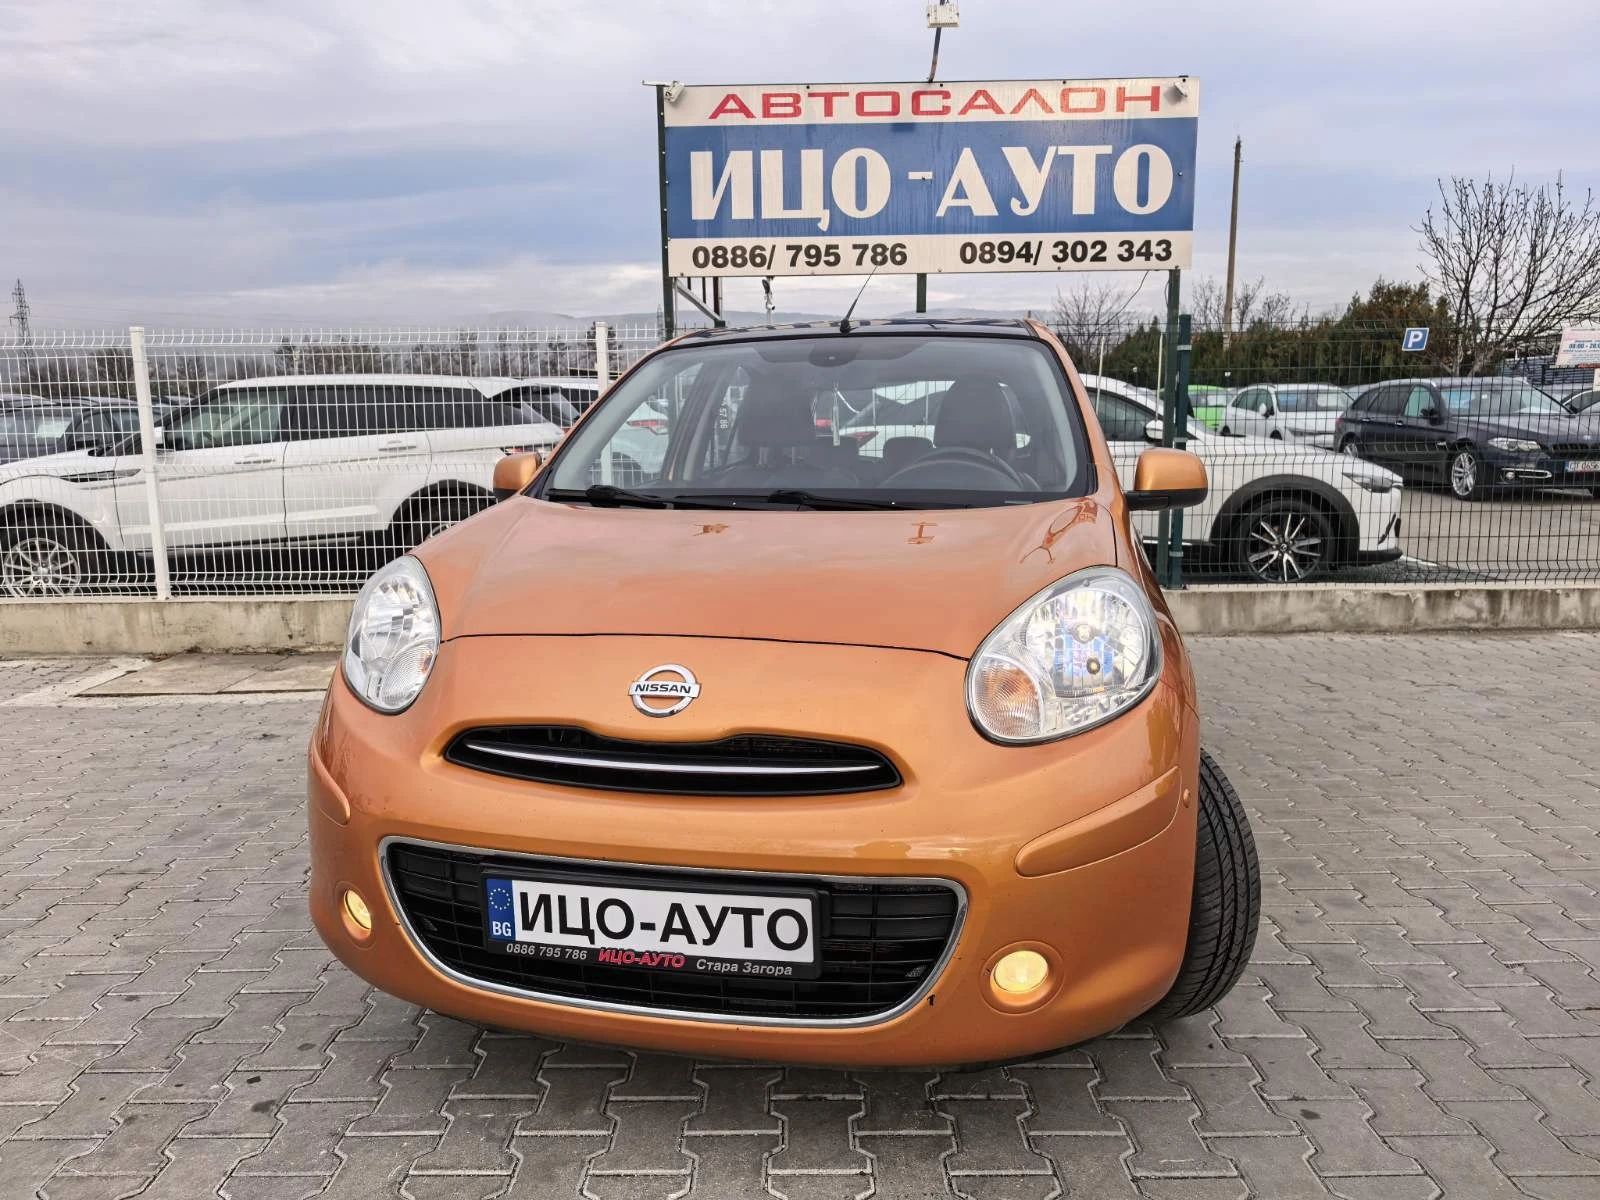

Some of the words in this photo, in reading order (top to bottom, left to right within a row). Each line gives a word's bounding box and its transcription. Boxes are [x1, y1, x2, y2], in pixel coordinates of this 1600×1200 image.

[708, 86, 1160, 119] АВТОСАЛОН
[692, 245, 776, 269] 0886/
[786, 244, 841, 267] 795
[852, 243, 907, 266] 786
[959, 240, 1043, 265] 0894/
[1052, 240, 1107, 263] 302
[1117, 239, 1172, 262] 343
[1408, 330, 1423, 348] P
[635, 684, 691, 694] NISSAN
[492, 921, 512, 937] BG
[519, 891, 808, 951] ИЦО-АУТО
[506, 943, 535, 955] 0886
[539, 946, 561, 958] 795
[565, 948, 588, 960] 786
[598, 948, 686, 968] ИЦО-АУТО
[696, 959, 738, 973] Стара
[743, 962, 793, 976] Загора
